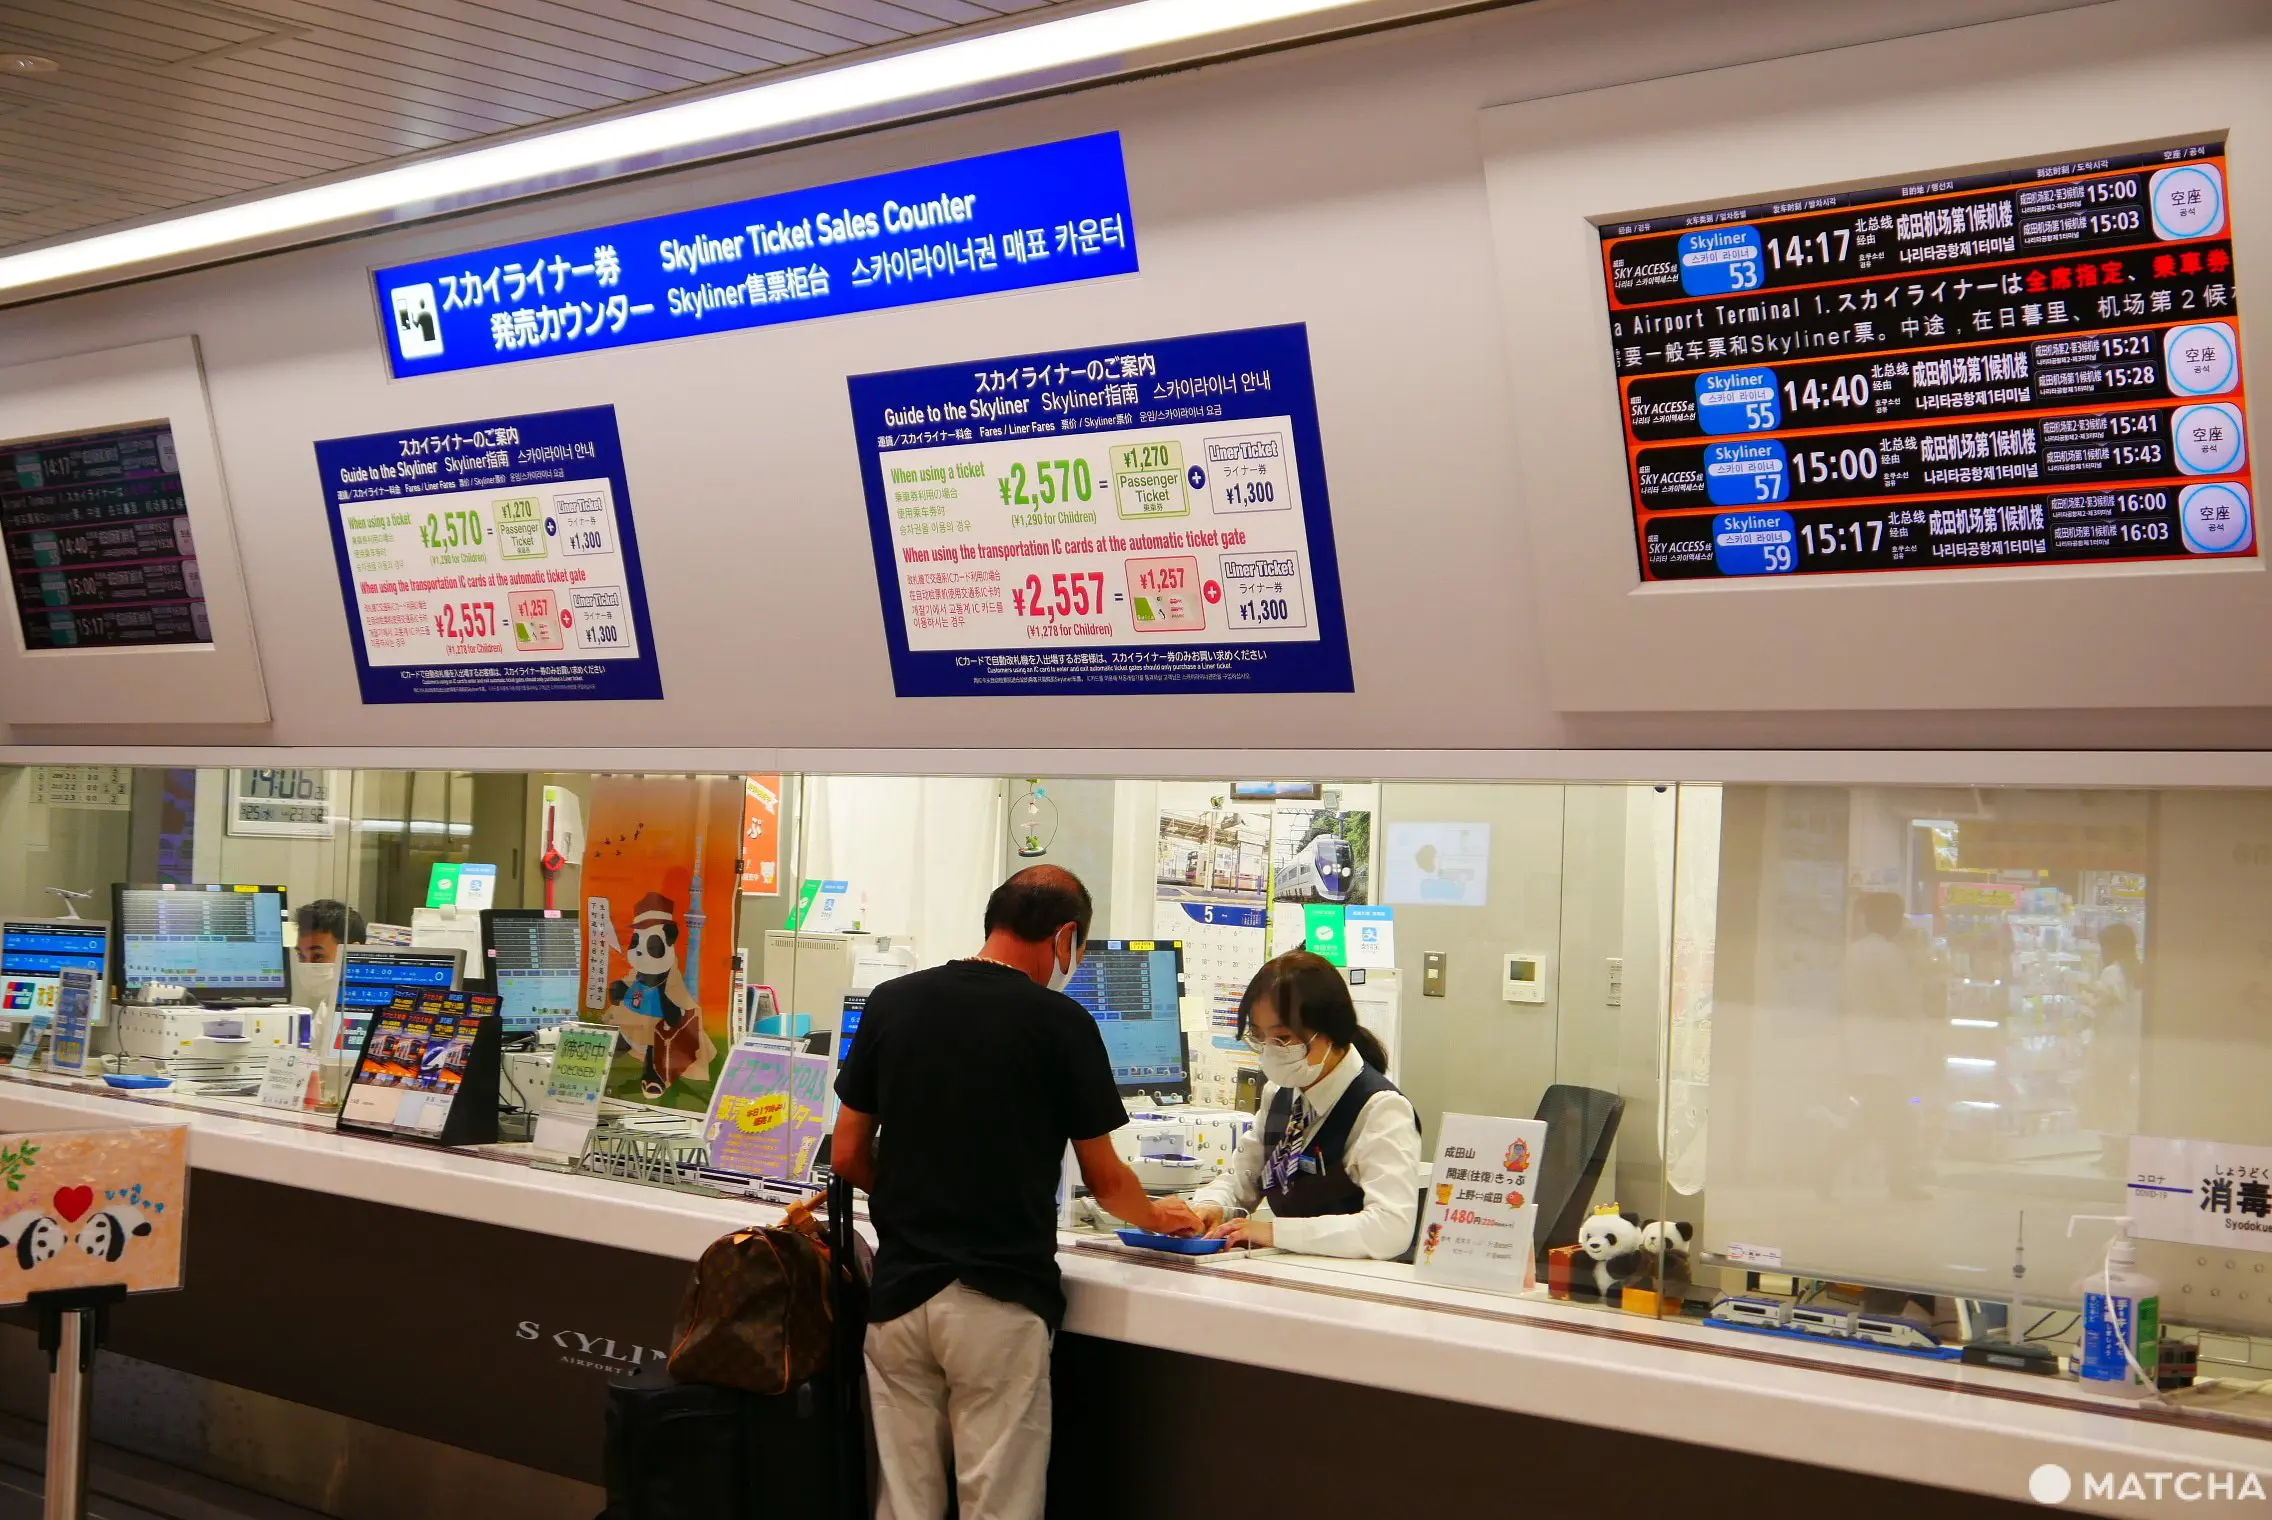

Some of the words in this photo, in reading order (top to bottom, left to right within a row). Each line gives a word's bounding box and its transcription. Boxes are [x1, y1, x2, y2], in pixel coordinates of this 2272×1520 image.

[2087, 179, 2137, 203] 15:00
[2171, 189, 2202, 206] 空座
[659, 233, 745, 275] Skyliner
[745, 217, 815, 255] Ticket
[815, 208, 881, 244] Sales
[883, 192, 977, 234] Counter
[2090, 210, 2140, 235] 15:03
[1690, 232, 1747, 250] Skyliner
[1767, 228, 1850, 269] 14:17
[1854, 215, 1894, 233] 北总线
[1896, 199, 2014, 241] 成田机场第1候机楼
[851, 233, 998, 287] 스카이라이너권
[1002, 227, 1050, 264] 매표
[1054, 212, 1126, 256] 카운터
[1900, 235, 2015, 264] 나리타공항제1터미널
[438, 244, 622, 312] スカイライナー券
[1614, 267, 1634, 280] SKY
[1729, 260, 1758, 289] 53
[666, 262, 831, 320] Skyliner售票柜台
[490, 294, 655, 351] 発売カウンター
[1633, 309, 1704, 335] Airport
[1716, 297, 1800, 326] Terminal
[2102, 335, 2150, 357] 15:21
[2185, 346, 2216, 363] 空座
[974, 352, 1156, 393] スカイライナーのご案内
[1707, 373, 1764, 391] Skyliner
[1784, 374, 1869, 411] 14:40
[1871, 362, 1910, 379] 北总线
[1912, 351, 2029, 388] 成田机场第1候机楼
[2105, 366, 2155, 387] 15:28
[884, 406, 925, 427] Guide
[927, 405, 941, 422] to
[943, 402, 967, 420] the
[969, 396, 1030, 421] Skyliner
[1041, 382, 1139, 414] Skyliner指南
[1153, 372, 1237, 399] 스카이라이너
[1241, 369, 1272, 392] 안내
[1916, 386, 2031, 410] 나리타공항제1터미널
[1631, 404, 1651, 416] SKY
[1745, 402, 1775, 430] 55
[979, 425, 1003, 438] Fares
[1008, 422, 1031, 435] Liner
[1031, 420, 1056, 433] Fares
[2110, 414, 2158, 435] 15:41
[2193, 426, 2224, 442] 空座
[398, 426, 520, 457] スカイライナーのご案内
[1208, 444, 1239, 462] Liner
[1239, 440, 1279, 459] Ticket
[340, 466, 369, 484] Guide
[369, 466, 379, 480] to
[380, 462, 397, 478] the
[398, 458, 438, 479] Skyliner
[444, 451, 510, 475] Skyliner指南
[517, 445, 574, 464] 스카이라이너
[575, 441, 596, 459] 안내
[1123, 445, 1169, 471] ¥1,270
[1716, 445, 1772, 461] Skyliner
[1792, 447, 1877, 483] 15:00
[1880, 436, 1918, 452] 北总线
[1921, 427, 2036, 462] 成田机场第1候机楼
[2113, 444, 2162, 466] 15:43
[890, 467, 918, 484] When
[919, 466, 947, 485] using
[948, 467, 955, 480] a
[956, 461, 985, 479] ticket
[1119, 474, 1178, 489] Passenger
[1223, 464, 1266, 477] ライナー券
[1640, 473, 1660, 486] SKY
[997, 457, 1092, 512] ¥2,570
[1136, 489, 1170, 502] Ticket
[1226, 480, 1274, 507] ¥1,300
[1754, 474, 1781, 500] 57
[501, 500, 532, 520] ¥1,270
[2117, 492, 2167, 513] 16:00
[2200, 505, 2231, 521] 空座
[347, 515, 366, 530] When
[368, 515, 386, 531] using
[391, 512, 412, 526] ticket
[500, 523, 539, 536] Passenger
[1011, 514, 1043, 528] (¥1,290
[1044, 513, 1057, 525] for
[1057, 510, 1097, 525] Children)
[1724, 516, 1781, 532] Skyliner
[1801, 520, 1883, 555] 15:17
[1888, 509, 1926, 526] 北总线
[1929, 503, 2045, 536] 成田机场第1候机楼
[420, 510, 483, 554] ¥2,570
[511, 536, 534, 546] Ticket
[569, 530, 601, 551] ¥1,300
[2120, 522, 2169, 543] 16:03
[902, 547, 930, 563] When
[931, 545, 959, 564] using
[960, 544, 976, 561] the
[977, 540, 1050, 561] transportation
[1051, 538, 1062, 555] IC
[1064, 537, 1094, 554] cards
[1096, 535, 1108, 551] at
[1109, 533, 1127, 551] the
[1128, 531, 1184, 550] automatic
[1185, 529, 1219, 548] ticket
[1221, 528, 1247, 550] gate
[1649, 542, 1670, 554] SKY
[1224, 562, 1256, 579] Liner
[1256, 559, 1295, 577] Ticket
[1763, 545, 1792, 571] 59
[359, 580, 379, 595] When
[379, 579, 398, 596] using
[398, 578, 409, 592] the
[409, 575, 458, 593] transportation
[458, 574, 467, 588] IC
[467, 572, 487, 588] cards
[487, 573, 496, 587] at
[496, 571, 508, 587] the
[508, 570, 546, 586] automatic
[546, 569, 568, 584] ticket
[568, 568, 587, 586] gate
[1139, 567, 1185, 592] ¥1,257
[1239, 582, 1283, 593] ライナー券
[518, 599, 548, 618] ¥1,257
[1011, 571, 1104, 624] ¥2,557
[434, 601, 497, 643] ¥2,557
[1240, 599, 1288, 624] ¥1,300
[585, 625, 617, 645] ¥1,300
[1026, 625, 1059, 639] (¥1,278
[1059, 624, 1072, 636] for
[1073, 623, 1113, 637] Children)
[1204, 905, 1214, 923] 5
[1445, 1145, 1476, 1159] 成田山
[2137, 1174, 2166, 1184] コロナ
[2215, 1164, 2269, 1179] しょうどく
[2200, 1177, 2272, 1218] 消毒
[560, 1356, 622, 1374] AIRPORT
